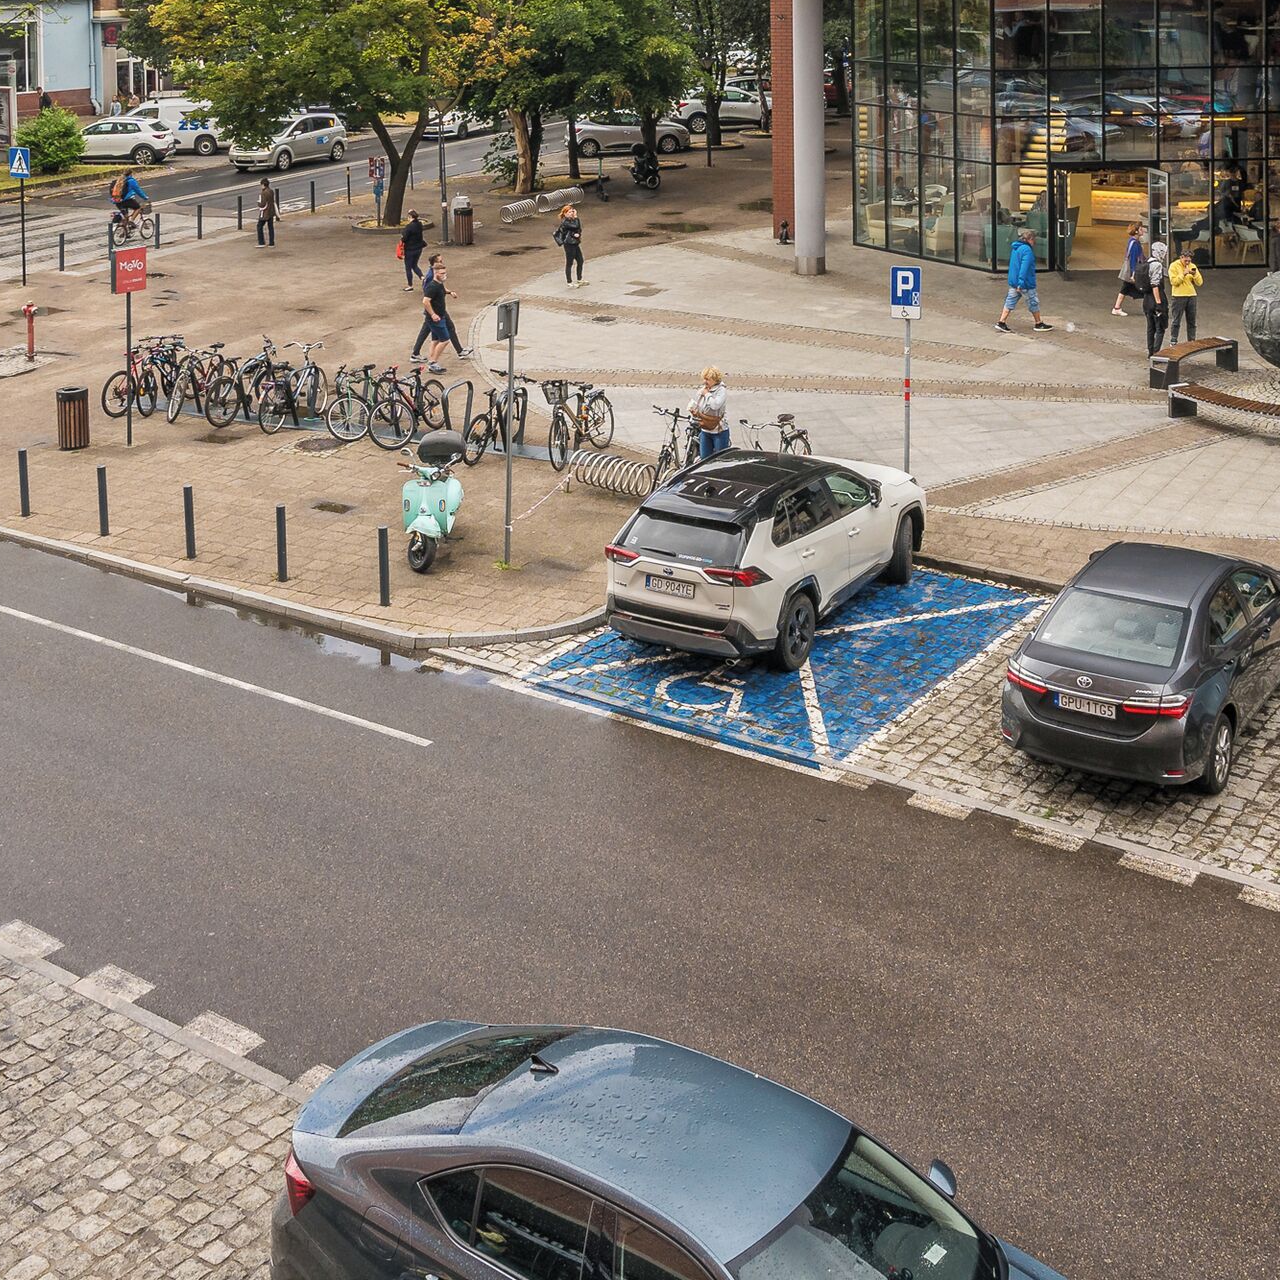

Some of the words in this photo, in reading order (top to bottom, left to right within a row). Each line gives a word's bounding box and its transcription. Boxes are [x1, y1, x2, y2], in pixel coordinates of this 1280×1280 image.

[897, 271, 914, 297] P
[651, 578, 663, 589] GD
[665, 582, 692, 595] 904YE
[1060, 695, 1082, 710] GPU
[1086, 700, 1114, 717] 1TG5
